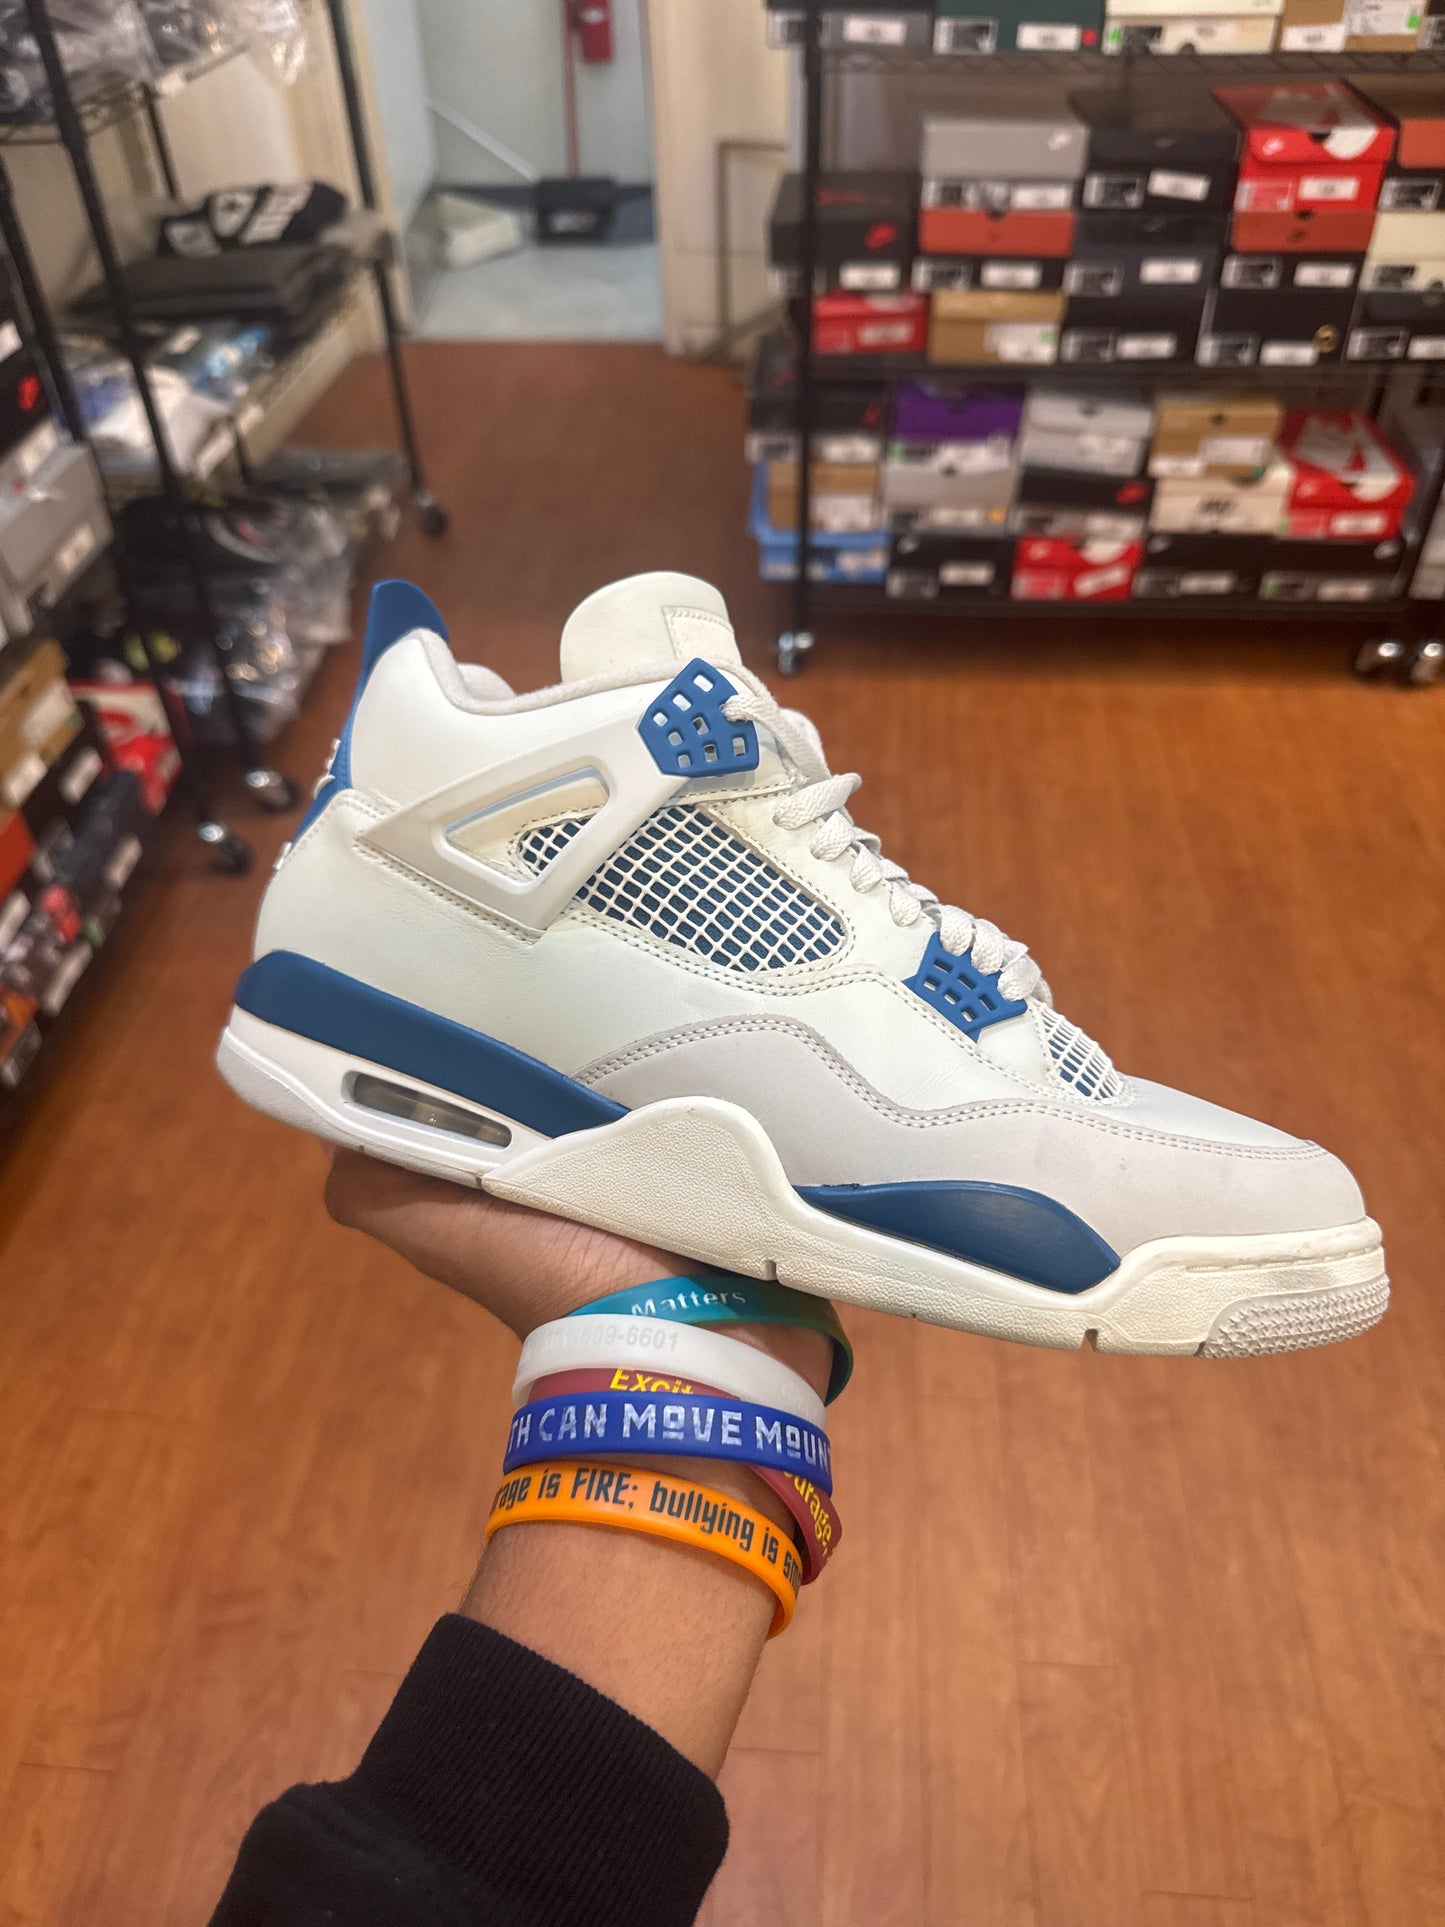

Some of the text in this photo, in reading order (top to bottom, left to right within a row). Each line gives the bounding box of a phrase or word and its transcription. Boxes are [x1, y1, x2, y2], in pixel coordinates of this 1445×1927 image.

[631, 1291, 747, 1317] Matters
[538, 1403, 608, 1442] CAN
[622, 1402, 743, 1447] MOVE
[755, 1415, 832, 1474] MOUN
[490, 1475, 532, 1517] rage
[537, 1468, 563, 1500] is
[570, 1467, 638, 1510] FIRE;
[649, 1480, 755, 1553] bullying
[761, 1526, 779, 1565] is
